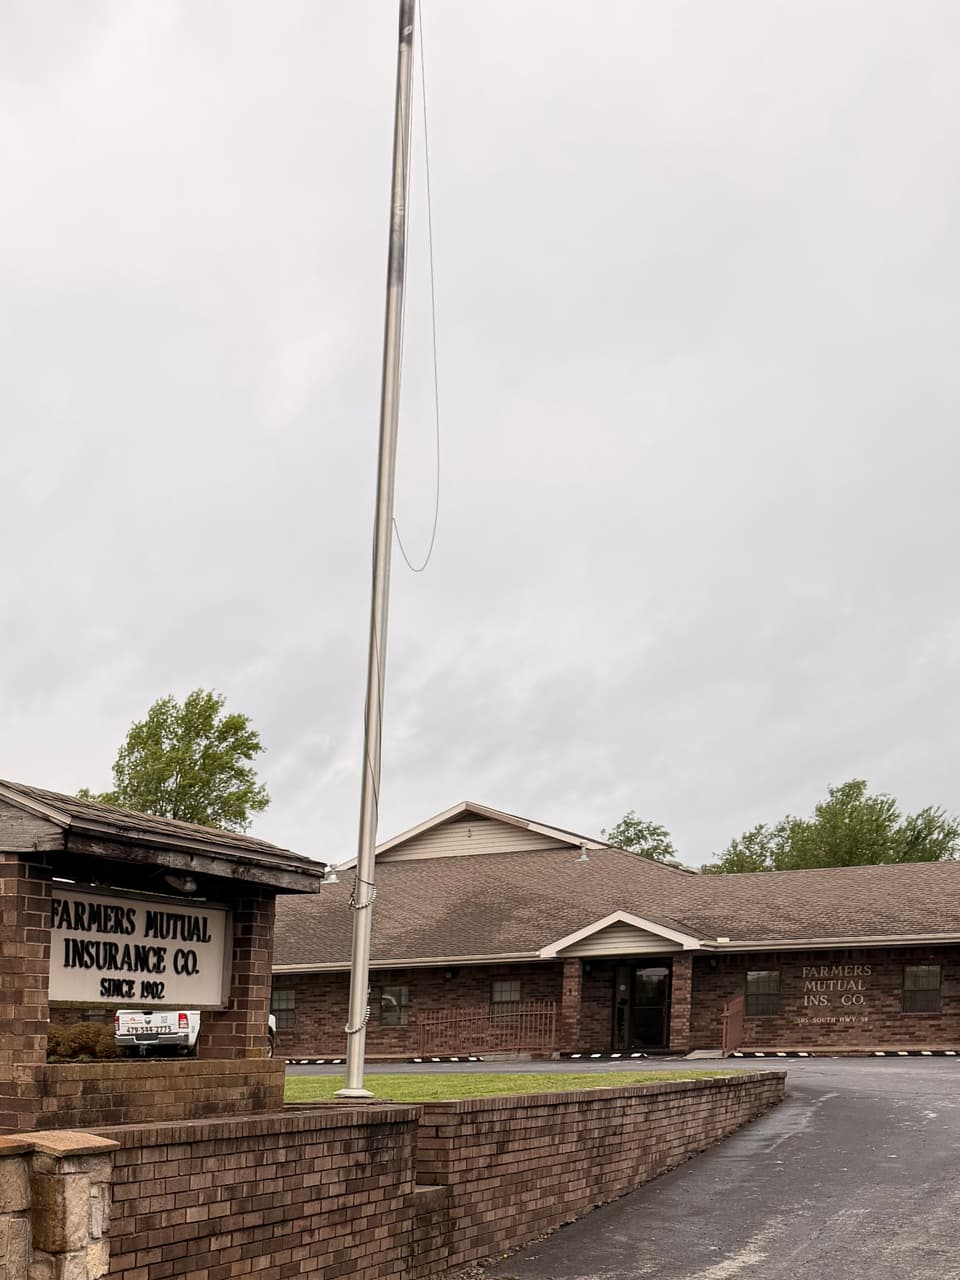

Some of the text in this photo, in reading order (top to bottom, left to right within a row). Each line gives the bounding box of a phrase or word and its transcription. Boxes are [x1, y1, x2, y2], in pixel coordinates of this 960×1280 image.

[51, 898, 211, 943] FARMERS MUTUAL
[63, 938, 200, 976] INSURANCE CO.
[802, 965, 872, 978] FARMERS
[100, 978, 165, 1000] SINCE 1902
[803, 980, 866, 992] MUTUAL
[803, 993, 866, 1006] INS. CO.
[839, 1015, 857, 1023] HWY
